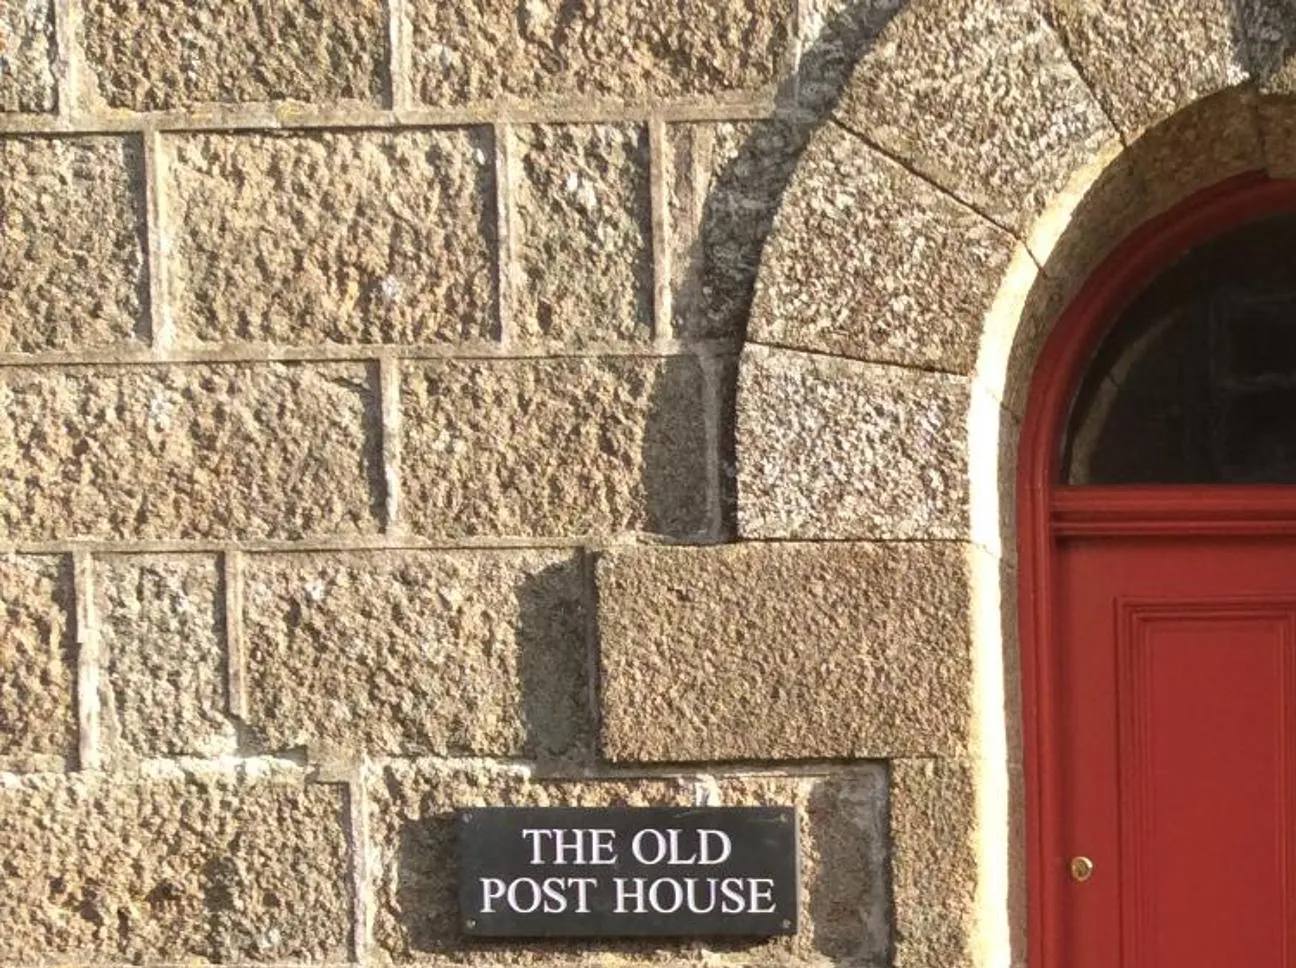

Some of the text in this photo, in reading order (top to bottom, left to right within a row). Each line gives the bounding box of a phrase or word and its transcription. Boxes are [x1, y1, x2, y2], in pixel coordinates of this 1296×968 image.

[521, 828, 732, 865] THE OLD
[479, 877, 777, 914] POST HOUSE
